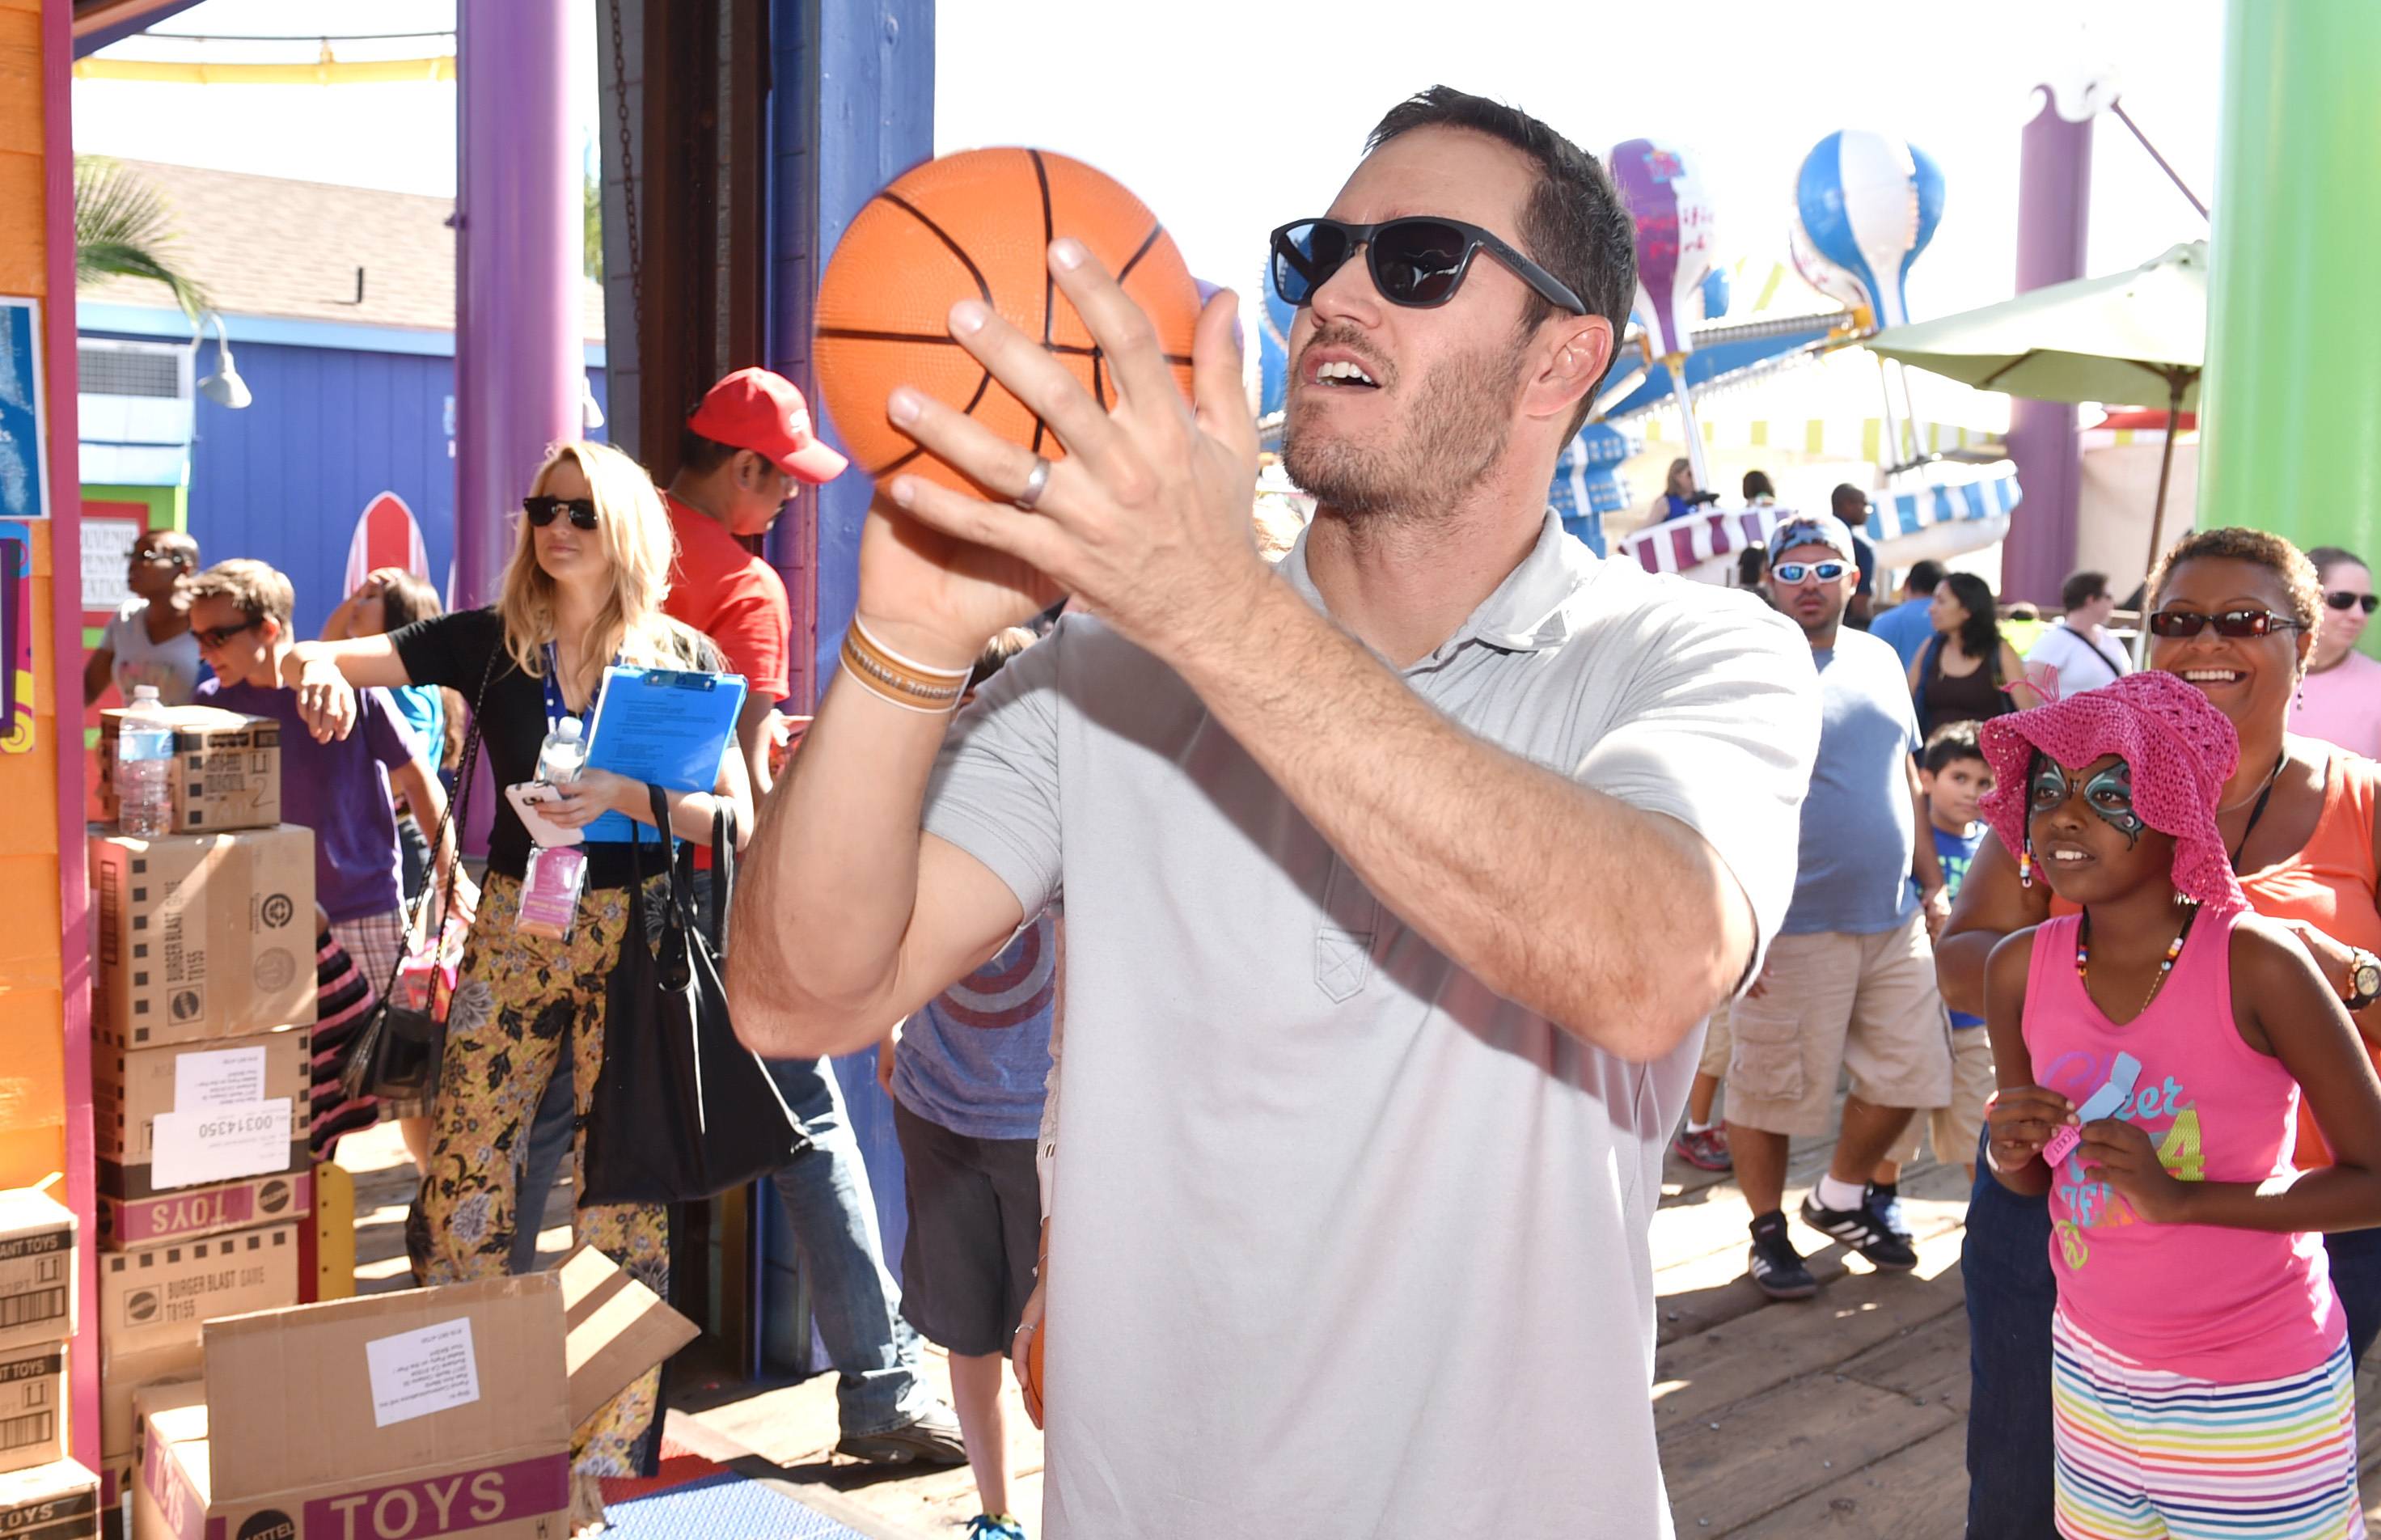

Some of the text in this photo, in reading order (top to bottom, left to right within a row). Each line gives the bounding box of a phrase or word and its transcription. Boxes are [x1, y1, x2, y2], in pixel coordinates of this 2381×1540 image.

[199, 1115, 273, 1139] 00314350
[2053, 1127, 2079, 1155] ICKET
[2157, 1110, 2205, 1181] 4
[151, 1193, 227, 1234] TOYS
[26, 1233, 59, 1254] TOYS
[207, 1270, 236, 1292] BLAST
[12, 1359, 46, 1378] TOYS
[329, 1471, 506, 1540] TOYS
